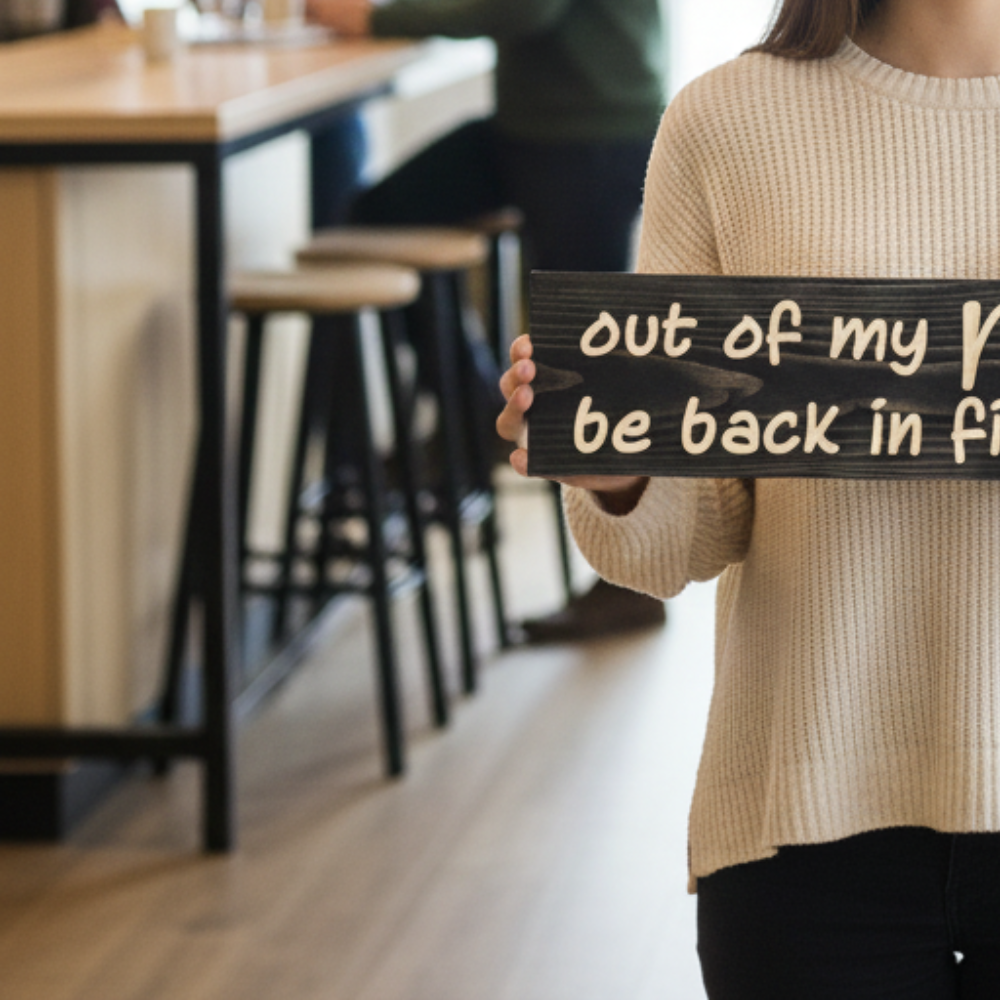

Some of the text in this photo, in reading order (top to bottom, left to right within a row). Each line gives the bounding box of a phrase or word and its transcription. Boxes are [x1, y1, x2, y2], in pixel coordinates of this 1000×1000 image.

[580, 302, 698, 357] out
[723, 299, 802, 366] of
[829, 316, 928, 376] my
[573, 396, 651, 454] be
[681, 396, 840, 455] back
[870, 396, 922, 456] in
